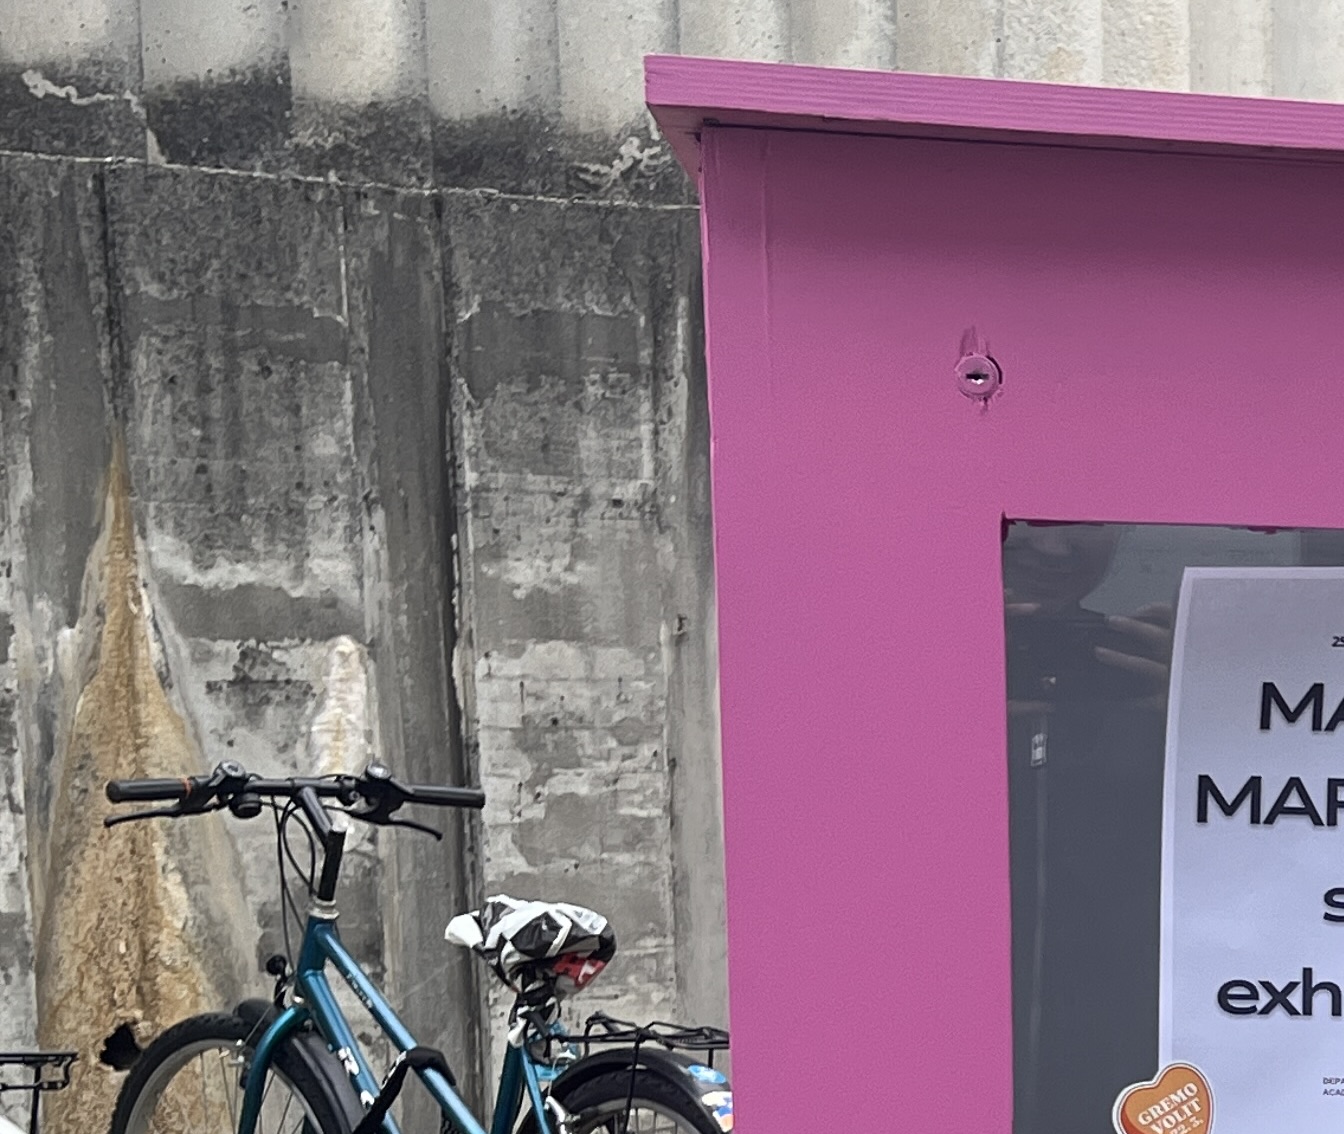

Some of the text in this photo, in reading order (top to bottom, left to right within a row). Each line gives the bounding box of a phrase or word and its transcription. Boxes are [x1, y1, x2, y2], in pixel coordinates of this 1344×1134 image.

[1138, 1082, 1198, 1125] GREMO
[1150, 1097, 1202, 1134] VOLIT
[1189, 1116, 1204, 1128] 3.
